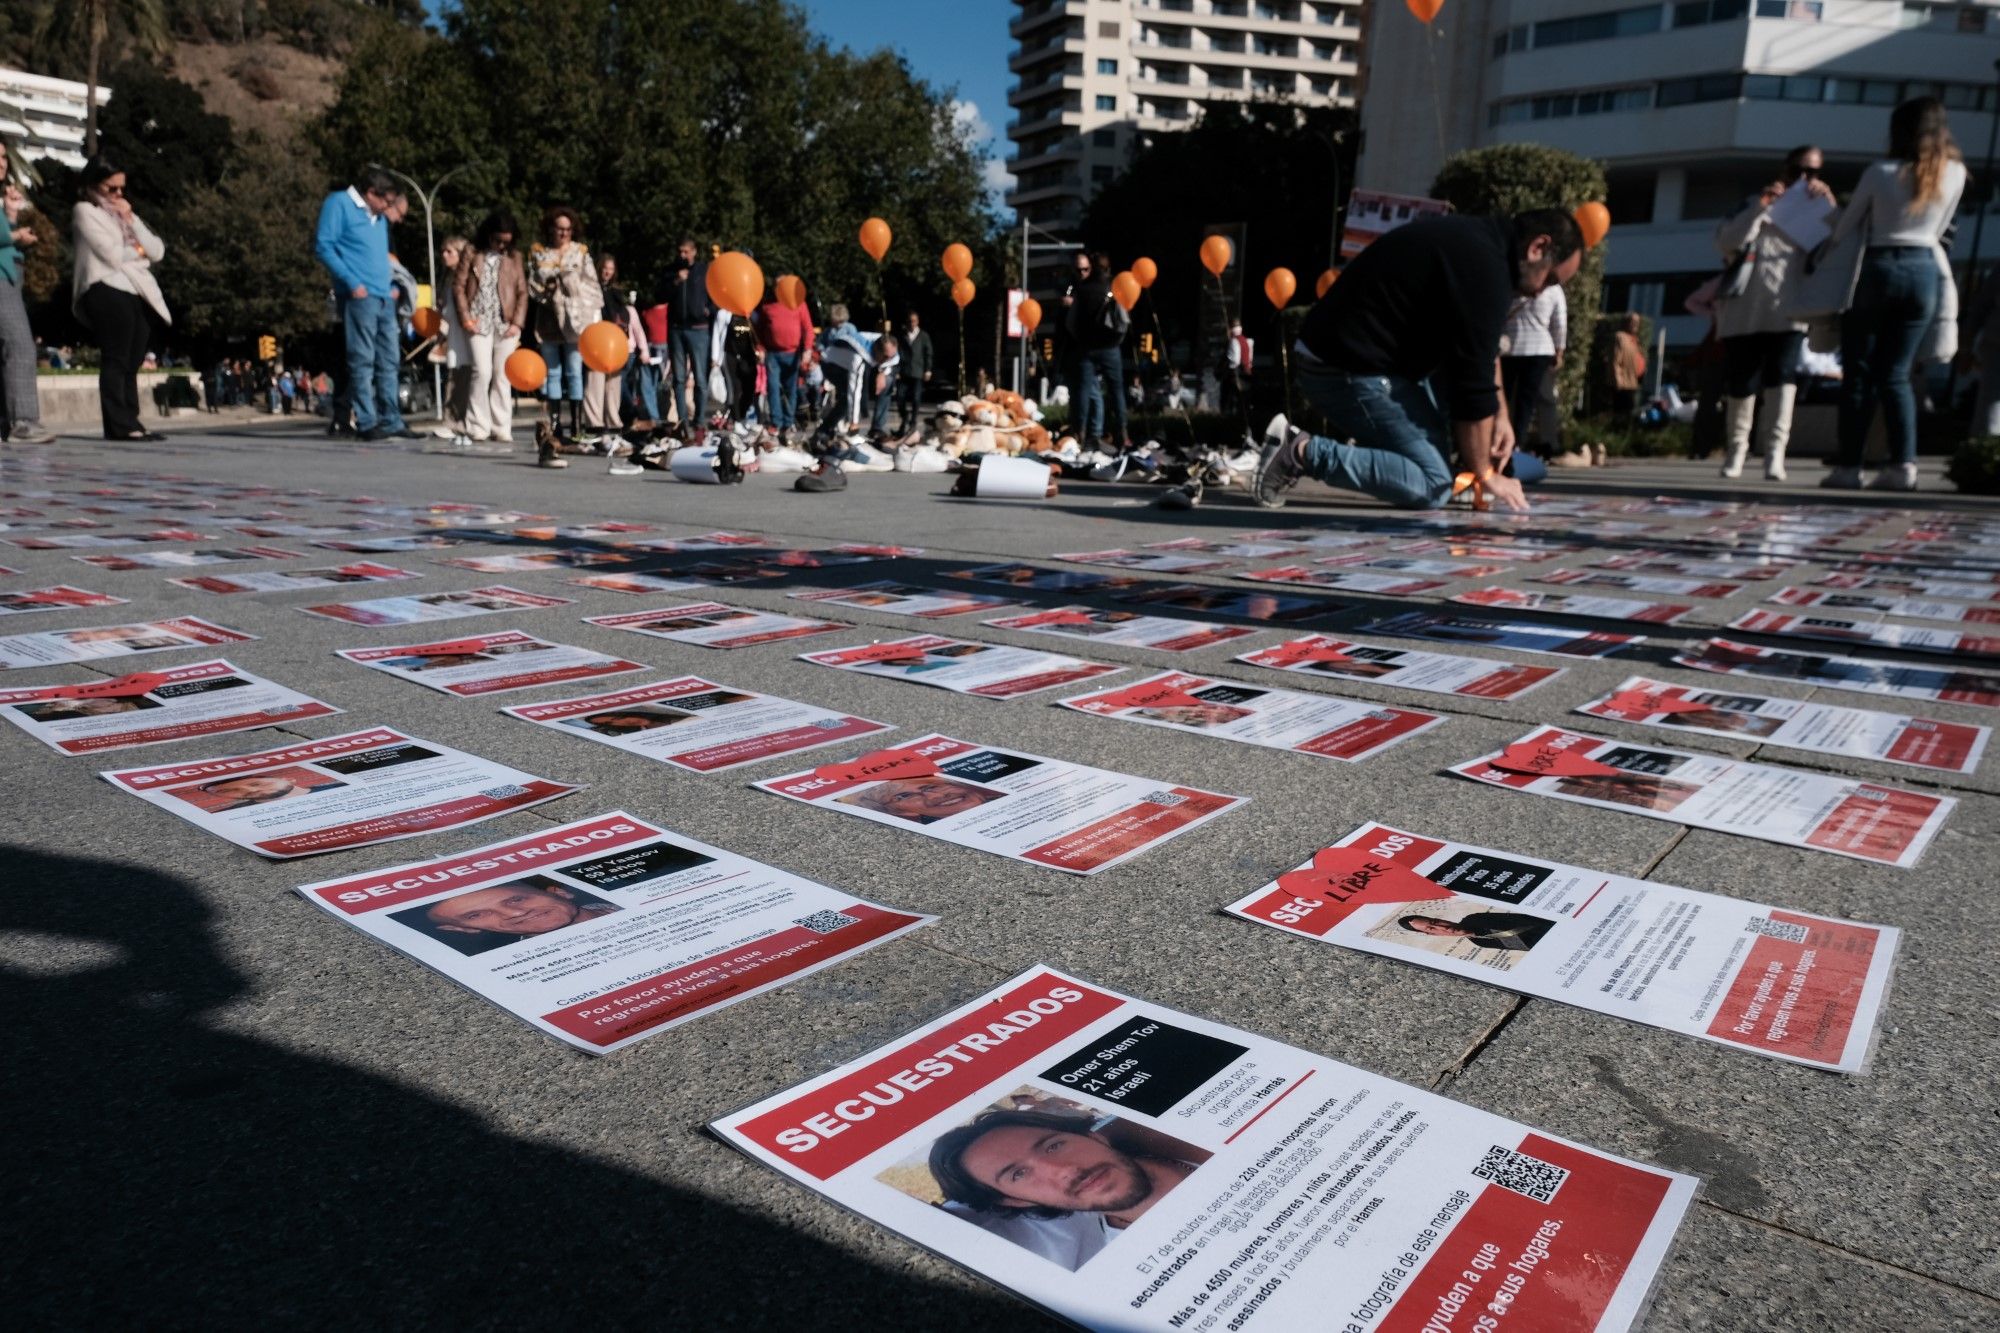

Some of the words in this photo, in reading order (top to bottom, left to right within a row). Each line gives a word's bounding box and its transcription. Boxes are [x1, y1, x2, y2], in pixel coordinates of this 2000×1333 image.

[526, 681, 706, 718] SECUESTRADOS
[124, 733, 392, 784] SECUESTRADOS
[1367, 834, 1414, 859] DOS
[336, 822, 636, 903] SECUESTRADOS
[570, 863, 604, 874] Yair
[607, 860, 646, 873] años
[1268, 896, 1324, 924] SEC
[555, 989, 599, 1006] Capte
[599, 980, 628, 991] una
[686, 953, 703, 961] de
[703, 944, 730, 956] este
[729, 927, 777, 946] mensaje
[1766, 959, 1785, 974] que
[1789, 972, 1807, 987] sus
[576, 1003, 611, 1019] Por
[612, 986, 658, 1006] favor
[660, 965, 721, 989] ayuden
[719, 960, 733, 968] a
[732, 949, 762, 963] que
[592, 994, 672, 1026] regresen
[671, 977, 717, 996] vivos
[729, 961, 760, 975] sus
[756, 938, 823, 963] hogares.
[1748, 976, 1776, 1003] ayuden
[1786, 984, 1802, 993] a
[1738, 1000, 1764, 1021] favor
[1775, 990, 1799, 1010] vivos
[1731, 1019, 1755, 1035] Por
[1764, 1008, 1797, 1042] regresen
[1059, 1058, 1102, 1083] Omer
[1095, 1036, 1139, 1060] Shem
[1129, 1022, 1160, 1037] Tov
[774, 986, 1084, 1153] SECUESTRADOS
[1081, 1077, 1106, 1092] 21
[1102, 1057, 1139, 1080] años
[1176, 1078, 1234, 1118] Secuestrado
[1229, 1067, 1247, 1081] por
[1240, 1061, 1257, 1070] la
[1206, 1074, 1261, 1115] organización
[1216, 1097, 1260, 1128] terrorista
[1251, 1076, 1286, 1099] Hamás
[1380, 1108, 1395, 1119] de
[1386, 1100, 1404, 1111] los
[1369, 1117, 1387, 1129] van
[1347, 1128, 1376, 1152] edades
[1327, 1150, 1353, 1171] cuyas
[1129, 1247, 1198, 1309] secuestrados
[1193, 1235, 1211, 1248] en
[1203, 1212, 1234, 1237] Israel
[1232, 1179, 1272, 1210] llevados
[1277, 1146, 1311, 1168] Franja
[1301, 1137, 1317, 1148] de
[1327, 1112, 1345, 1122] Su
[1339, 1087, 1370, 1115] paradero
[1135, 1261, 1153, 1275] El
[1145, 1253, 1159, 1264] 7
[1157, 1243, 1175, 1257] de
[1170, 1213, 1212, 1245] octubre,
[1205, 1190, 1234, 1213] cerca
[1228, 1179, 1245, 1192] de
[1237, 1166, 1259, 1182] 230
[1255, 1145, 1284, 1168] civiles
[1276, 1116, 1317, 1147] inocentes
[1309, 1097, 1338, 1118] fueron
[1213, 1283, 1248, 1315] meses
[1246, 1261, 1268, 1277] los
[1260, 1248, 1279, 1263] 85
[1273, 1230, 1303, 1252] años,
[1292, 1204, 1324, 1229] fueron
[1318, 1162, 1368, 1206] maltratados,
[1360, 1134, 1396, 1162] violados,
[1385, 1109, 1420, 1134] heridos,
[1226, 1210, 1254, 1233] sigue
[1248, 1186, 1279, 1212] siendo
[1262, 1197, 1305, 1234] hombres
[1350, 1196, 1385, 1224] Hamas.
[1226, 1276, 1282, 1332] asesinados
[1279, 1223, 1332, 1271] brutalmente
[1326, 1186, 1368, 1225] separados
[1361, 1176, 1377, 1187] de
[1370, 1163, 1389, 1178] sus
[1382, 1146, 1405, 1165] seres
[1398, 1120, 1429, 1148] queridos
[1332, 1231, 1351, 1248] por
[1345, 1221, 1359, 1233] el
[1228, 1234, 1272, 1271] mujeres,
[1349, 1266, 1408, 1323] fotografía
[1396, 1251, 1419, 1268] de
[1411, 1228, 1438, 1252] este
[1429, 1189, 1470, 1230] mensaje
[1470, 1242, 1501, 1270] que
[1507, 1218, 1564, 1274] hogares.
[1204, 1268, 1233, 1292] 4500
[1461, 1269, 1482, 1283] a
[1494, 1272, 1526, 1304] sus
[1191, 1291, 1210, 1306] de
[1486, 1301, 1507, 1316] a
[1167, 1305, 1197, 1328] Más
